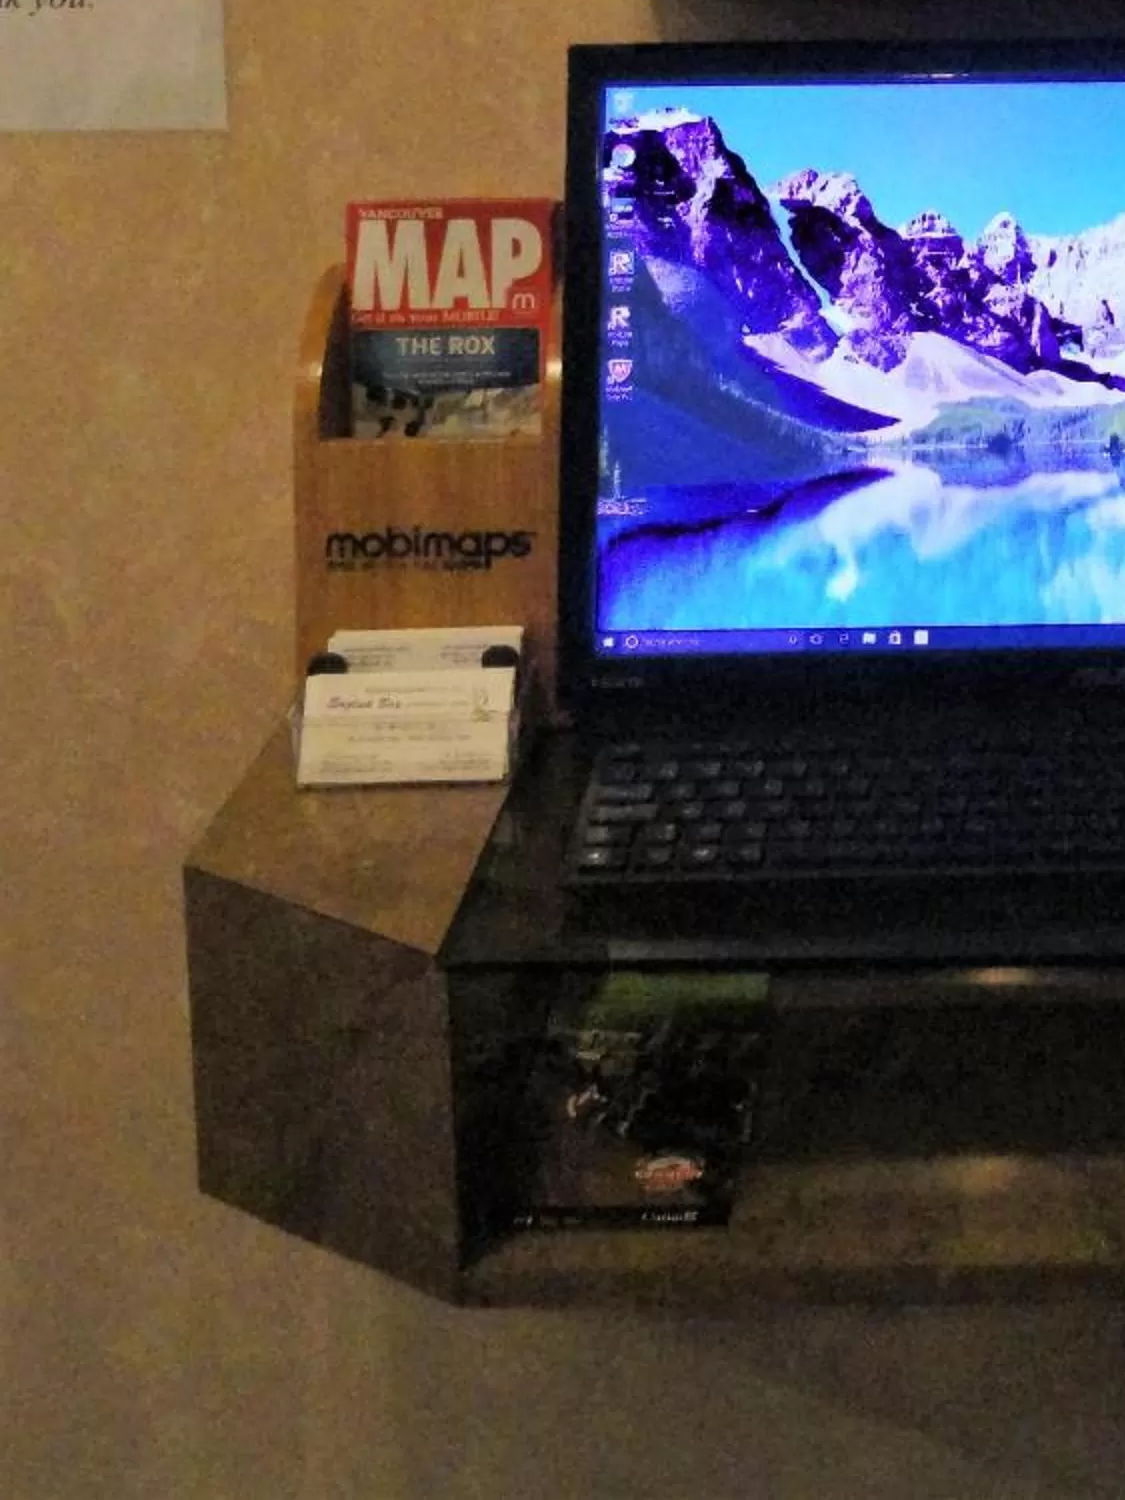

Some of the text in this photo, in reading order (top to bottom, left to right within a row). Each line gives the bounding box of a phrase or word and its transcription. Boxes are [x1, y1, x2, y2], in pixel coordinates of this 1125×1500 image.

[351, 217, 543, 312] MAP
[395, 335, 496, 356] THE ROX
[325, 526, 539, 571] mobimaps
